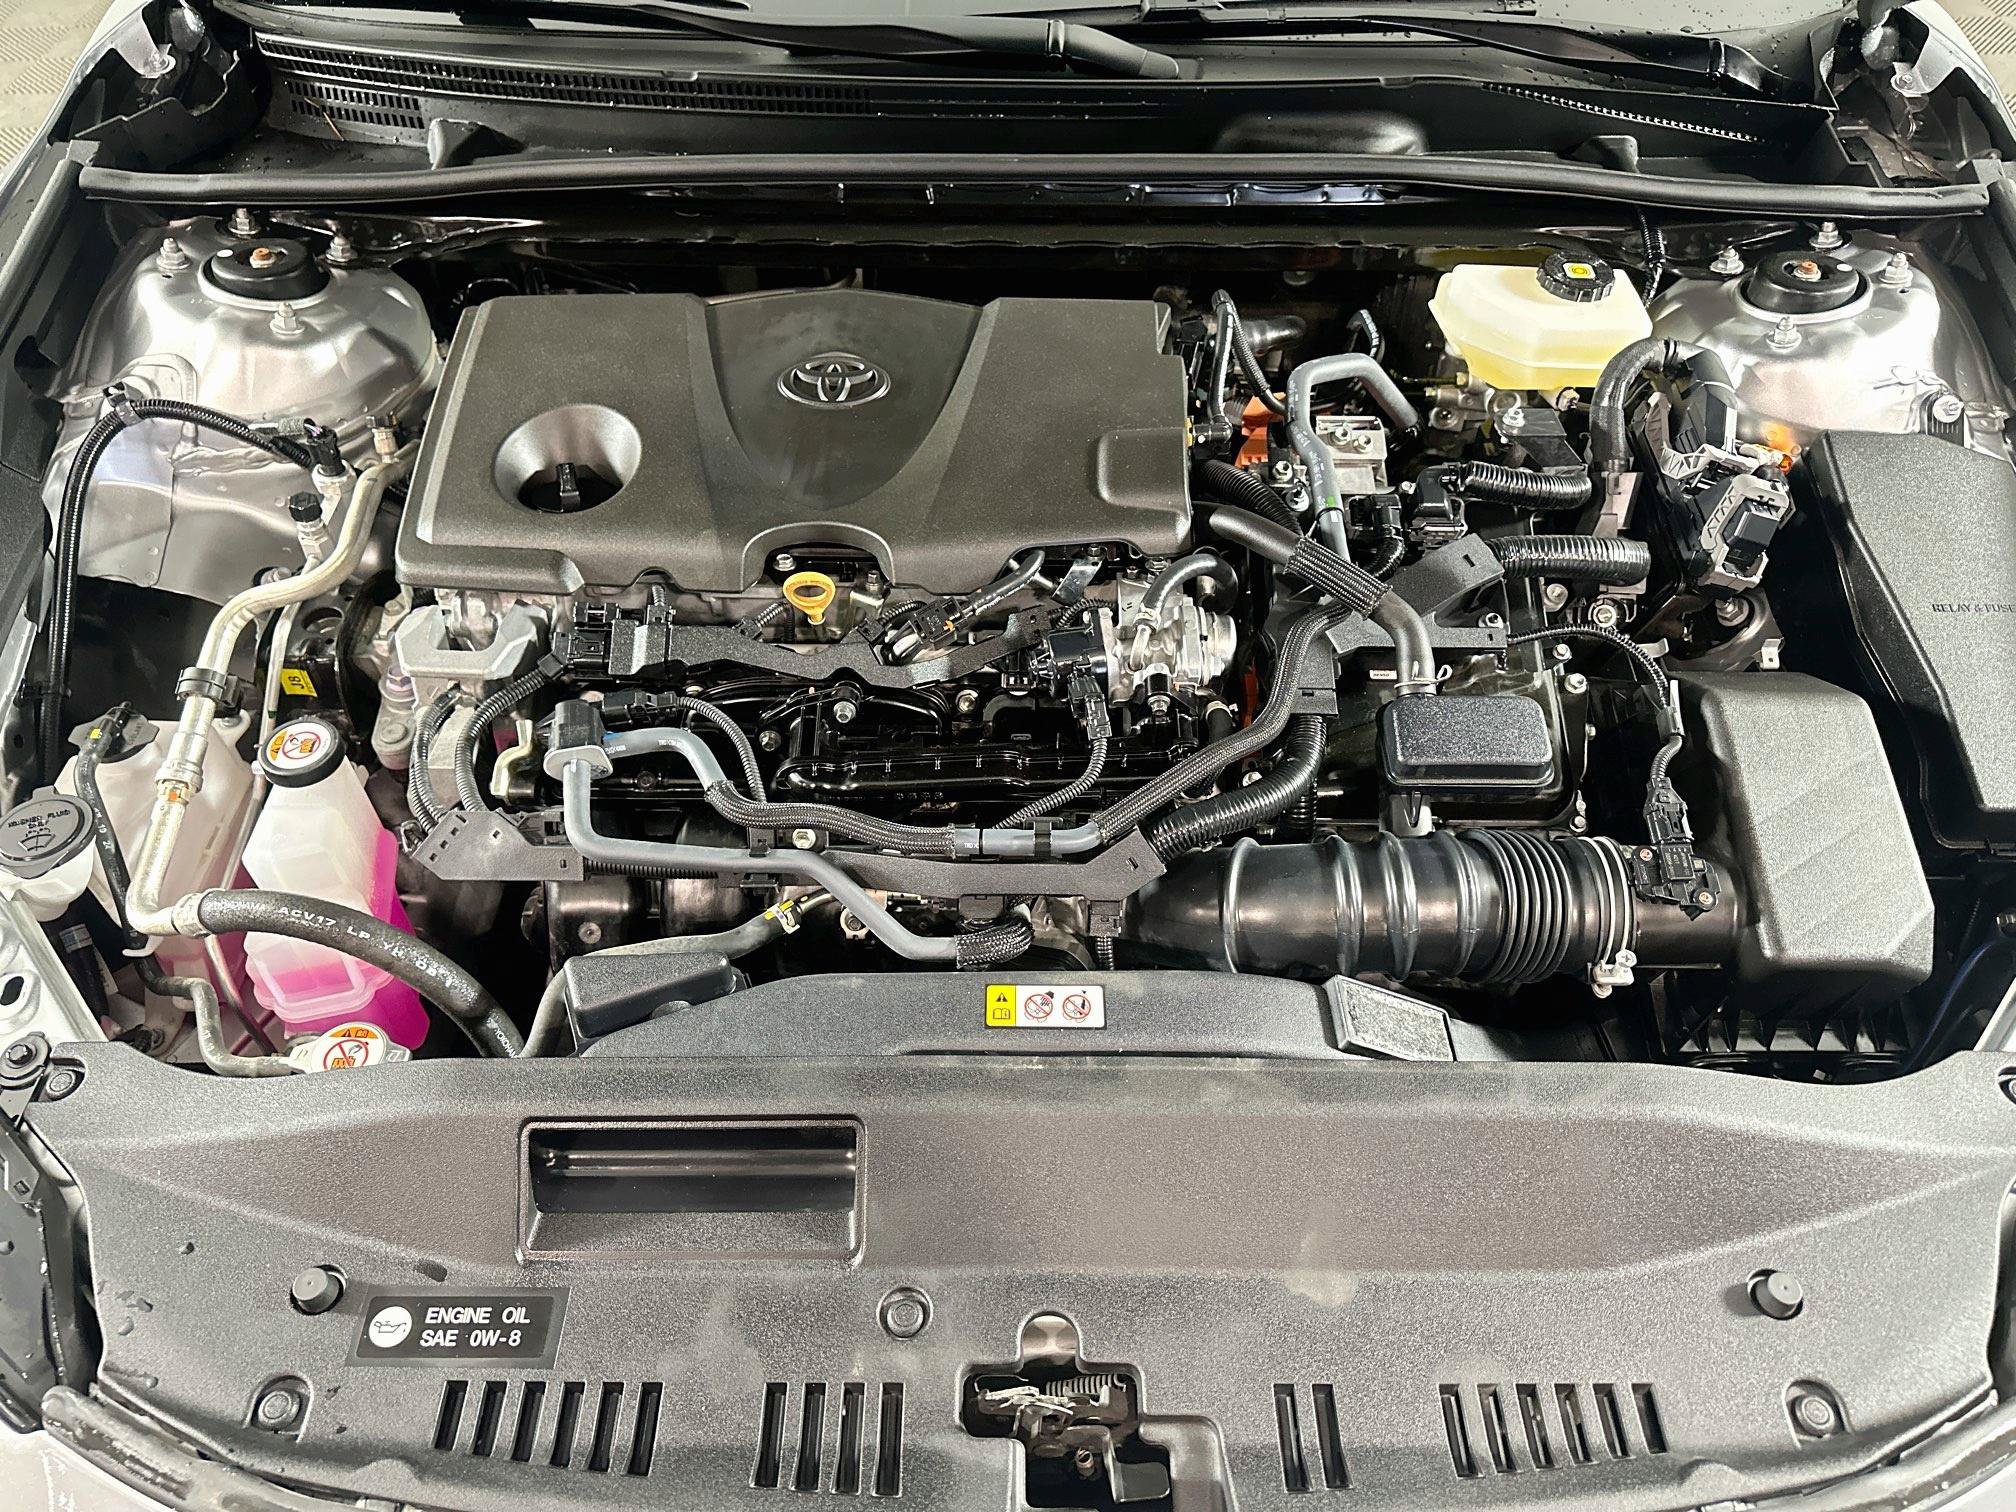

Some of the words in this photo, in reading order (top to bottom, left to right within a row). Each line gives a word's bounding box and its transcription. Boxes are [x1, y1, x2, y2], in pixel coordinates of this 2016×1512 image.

[1931, 603, 1970, 613] RELAY
[1984, 603, 2016, 613] FUSE
[278, 906, 337, 926] ACV17
[424, 1306, 492, 1324] ENGINE
[501, 1306, 531, 1324] OIL
[419, 1329, 459, 1348] SAE
[469, 1329, 521, 1348] 0W-8
